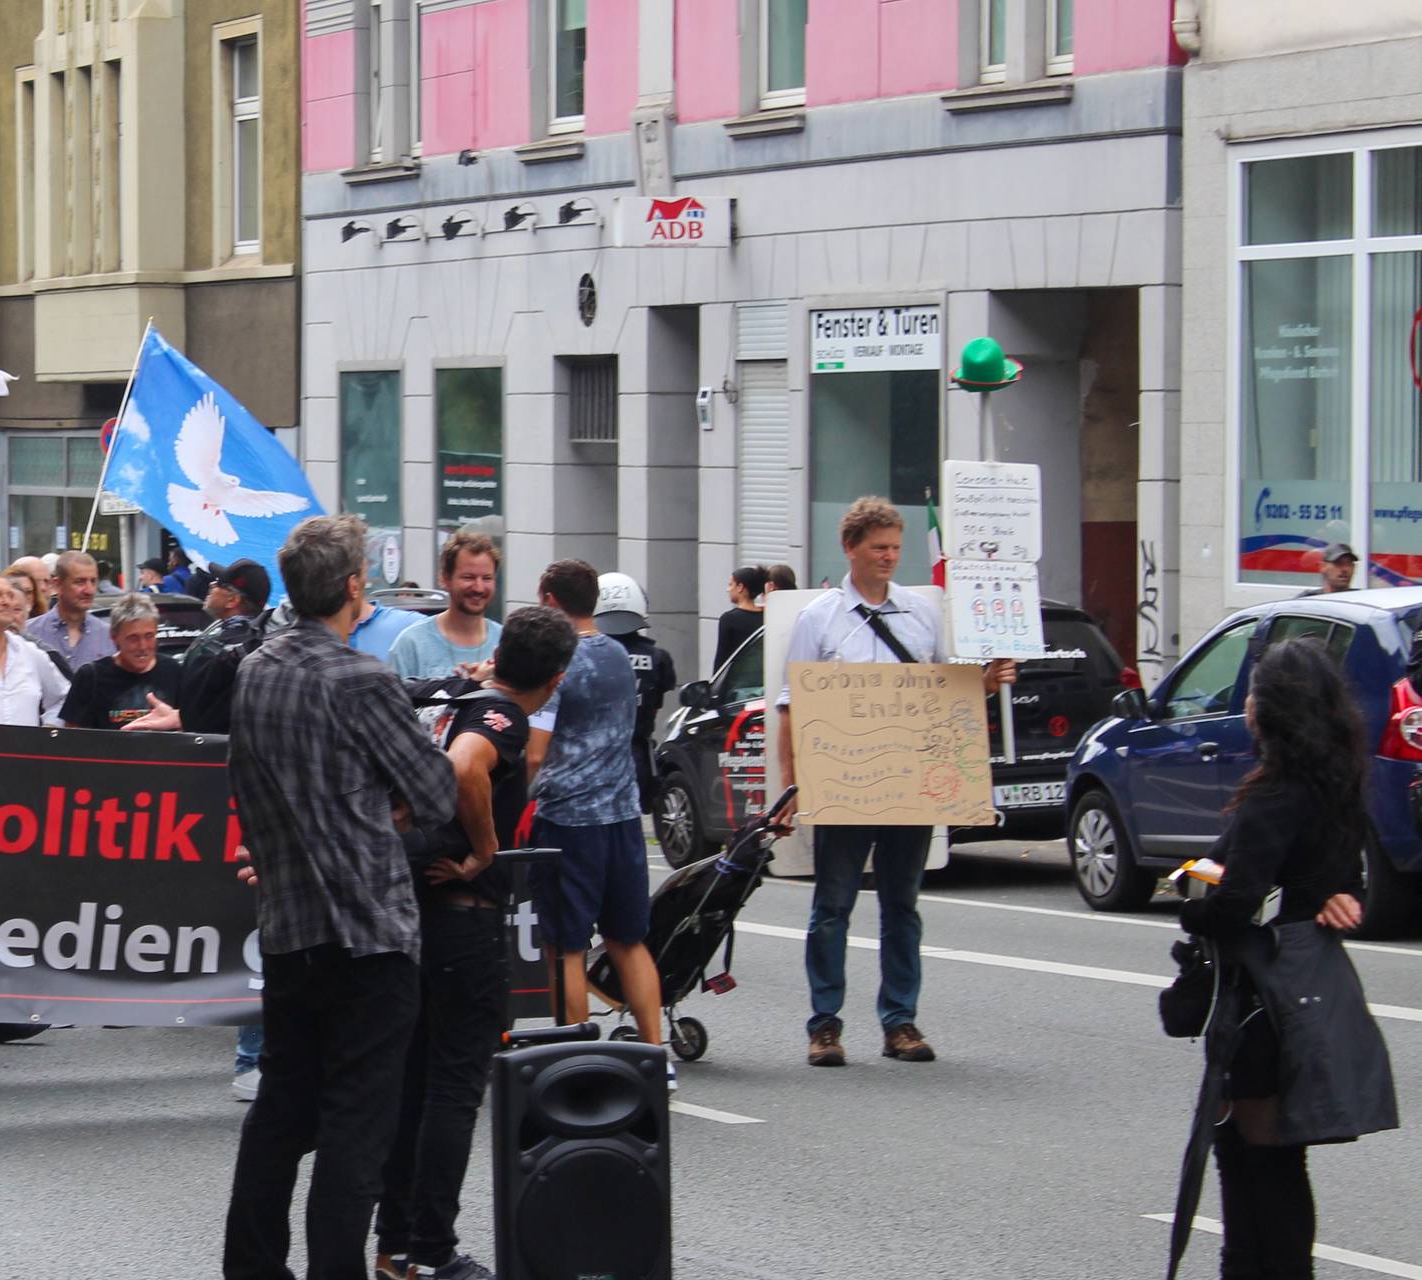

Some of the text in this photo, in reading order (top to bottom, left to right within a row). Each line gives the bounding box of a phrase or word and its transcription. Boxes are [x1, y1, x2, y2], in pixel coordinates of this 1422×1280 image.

[650, 221, 704, 240] ADB
[816, 308, 940, 339] Fenster & Türen
[1265, 504, 1290, 520] 0202
[1299, 504, 1312, 520] 55
[1314, 504, 1327, 520] 25
[1330, 505, 1343, 520] 11
[800, 669, 882, 692] Corona
[849, 692, 941, 720] Ende?
